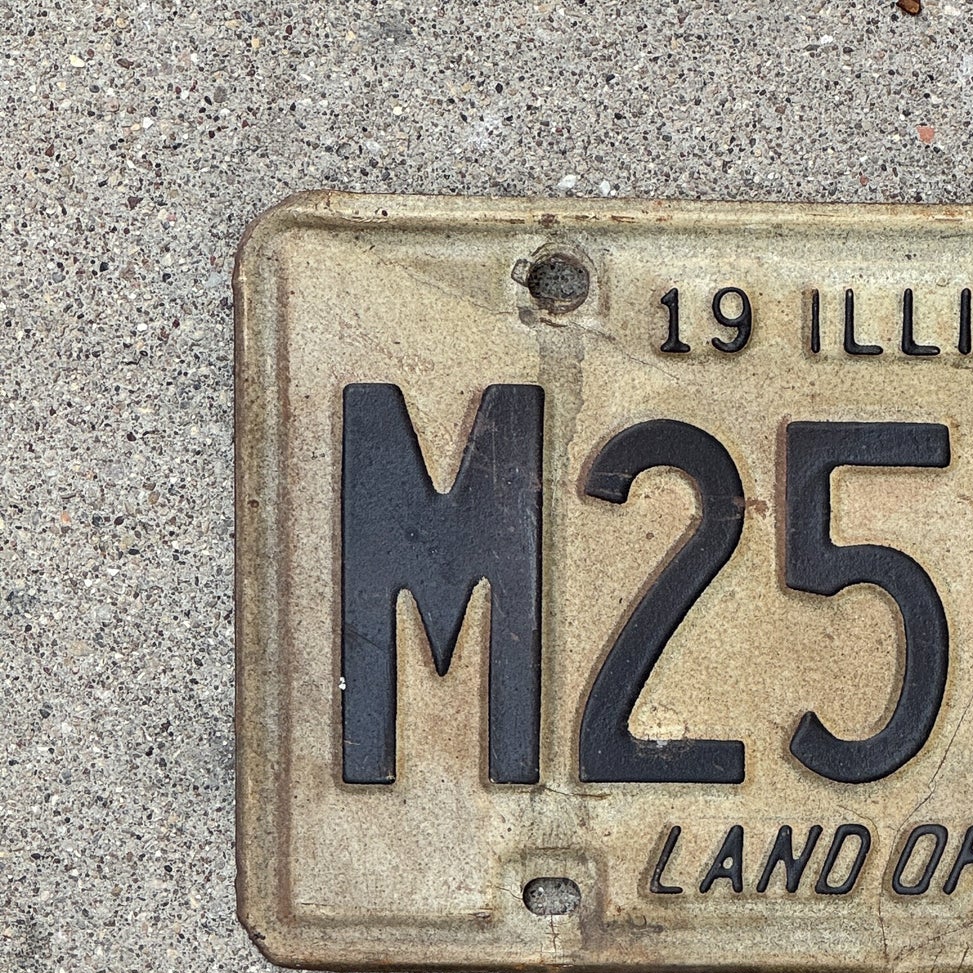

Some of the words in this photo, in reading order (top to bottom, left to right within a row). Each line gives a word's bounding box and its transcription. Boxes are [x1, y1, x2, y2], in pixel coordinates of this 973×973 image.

[659, 286, 753, 354] 19
[341, 382, 952, 785] M25
[650, 823, 872, 896] LAND
